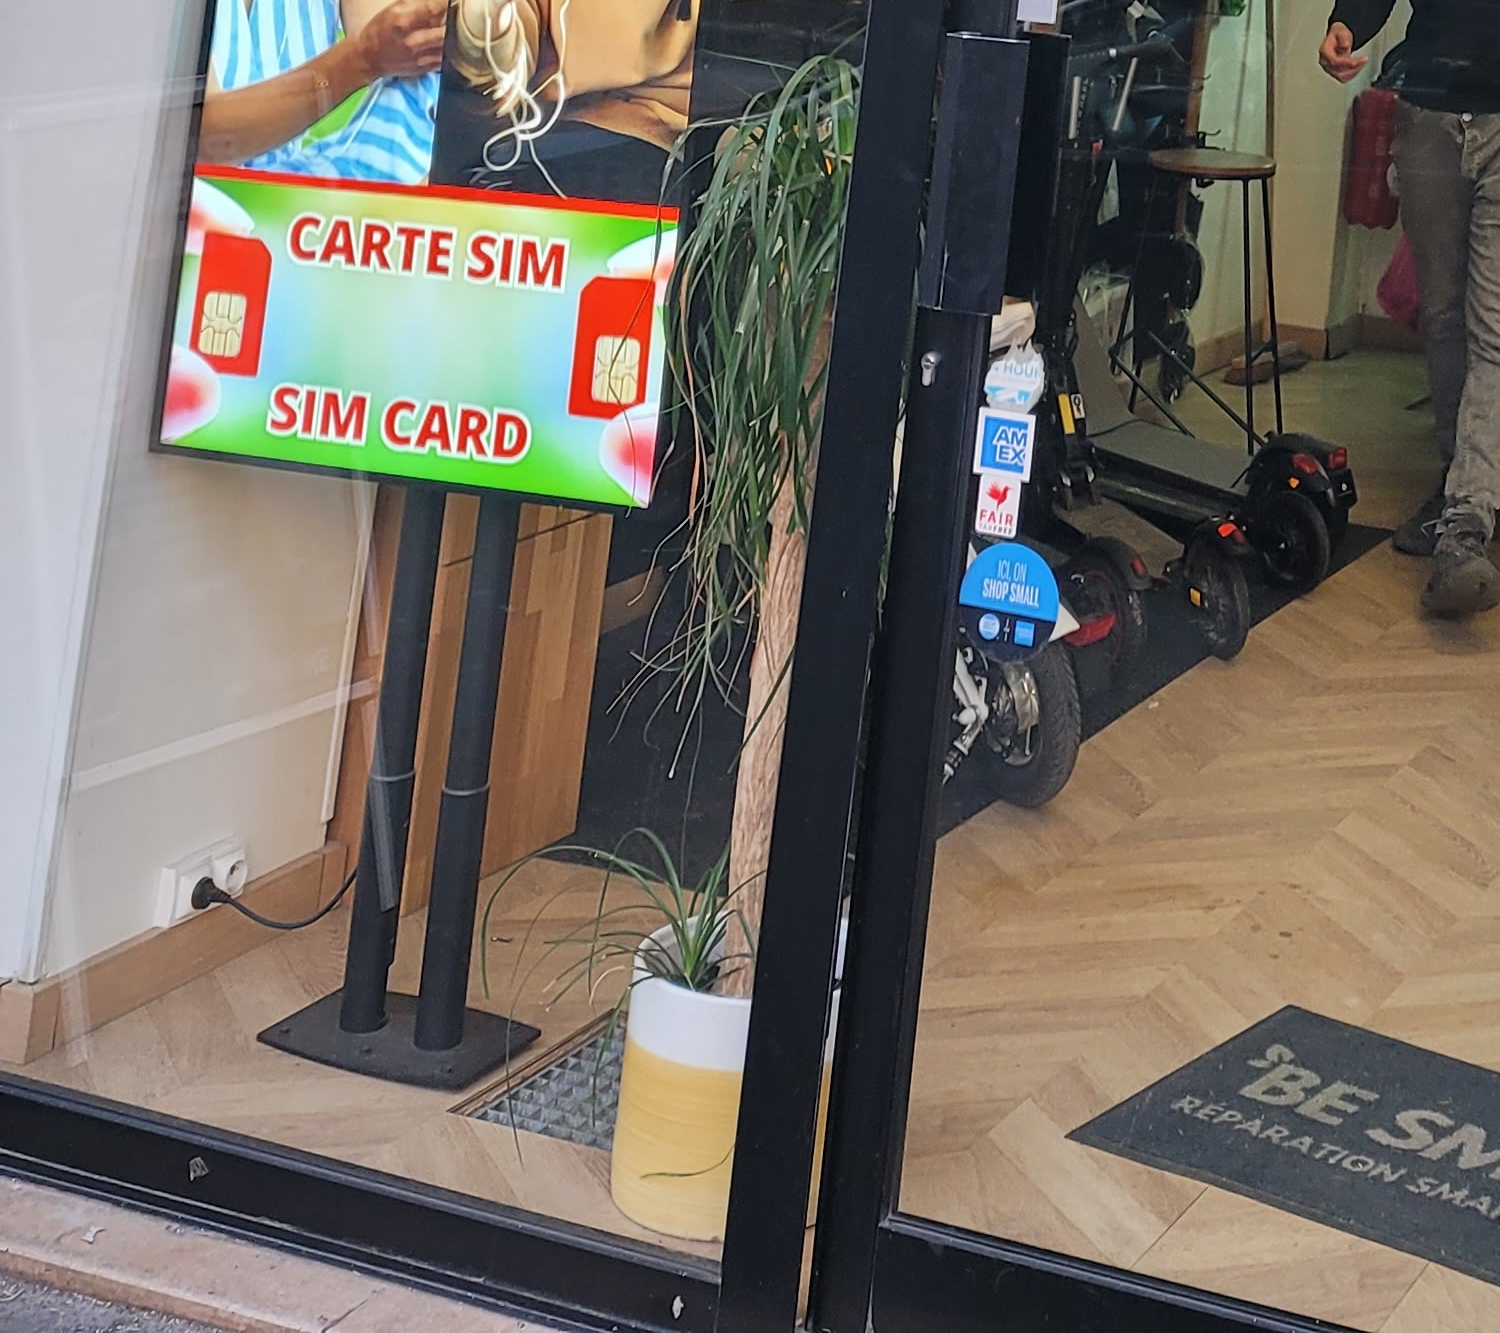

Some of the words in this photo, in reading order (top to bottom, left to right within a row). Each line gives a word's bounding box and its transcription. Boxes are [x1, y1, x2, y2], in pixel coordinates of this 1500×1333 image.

[286, 213, 458, 282] CARTE
[465, 228, 570, 294] SIM
[267, 382, 372, 447] SIM
[381, 396, 532, 465] CARD
[993, 425, 1029, 447] AM
[996, 443, 1026, 466] EX
[979, 508, 1014, 526] FAIR
[997, 559, 1012, 582] ICI,
[1013, 561, 1028, 583] ON
[982, 577, 1009, 602] SHOP
[1009, 582, 1040, 608] SMALL
[1239, 1062, 1380, 1126] BE
